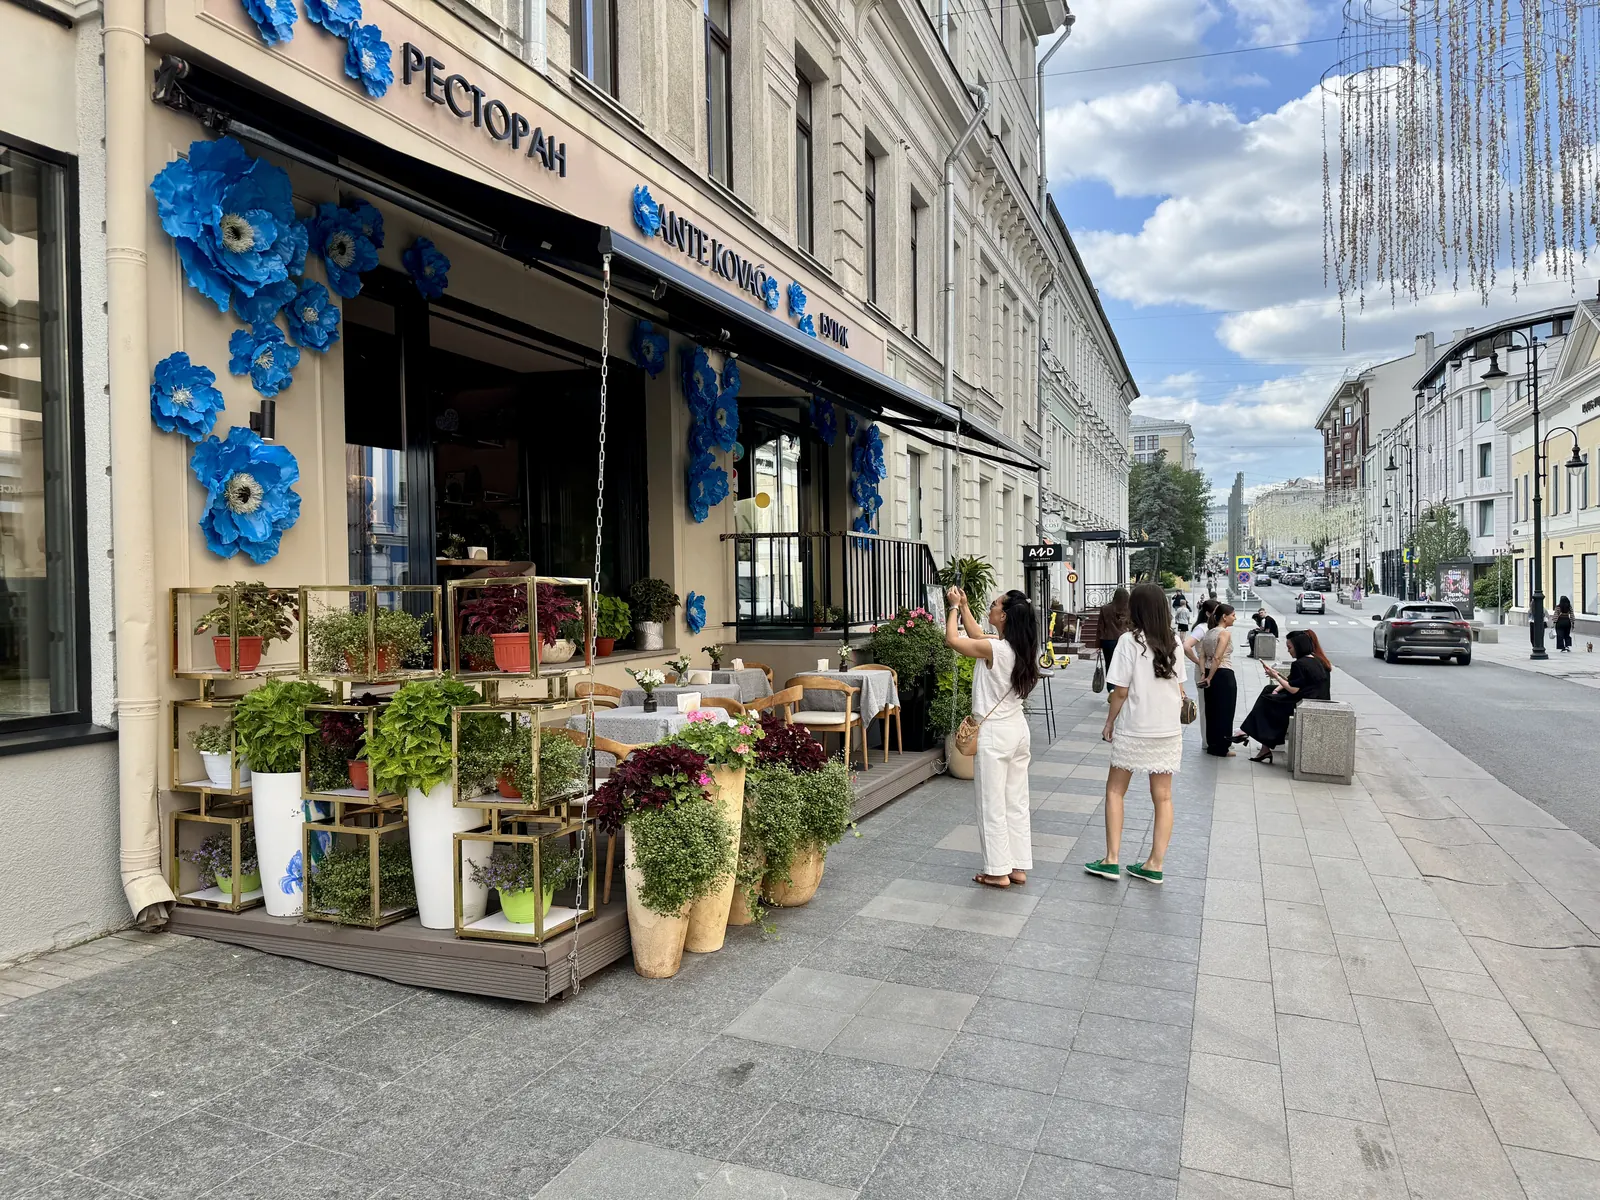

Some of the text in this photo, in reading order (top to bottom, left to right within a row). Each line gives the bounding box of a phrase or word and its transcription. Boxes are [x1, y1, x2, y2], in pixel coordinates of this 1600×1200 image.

[402, 41, 567, 178] РЕСТОРАН
[656, 203, 709, 266] ANTE
[819, 312, 849, 349] БУТИК
[1028, 547, 1055, 558] AND
